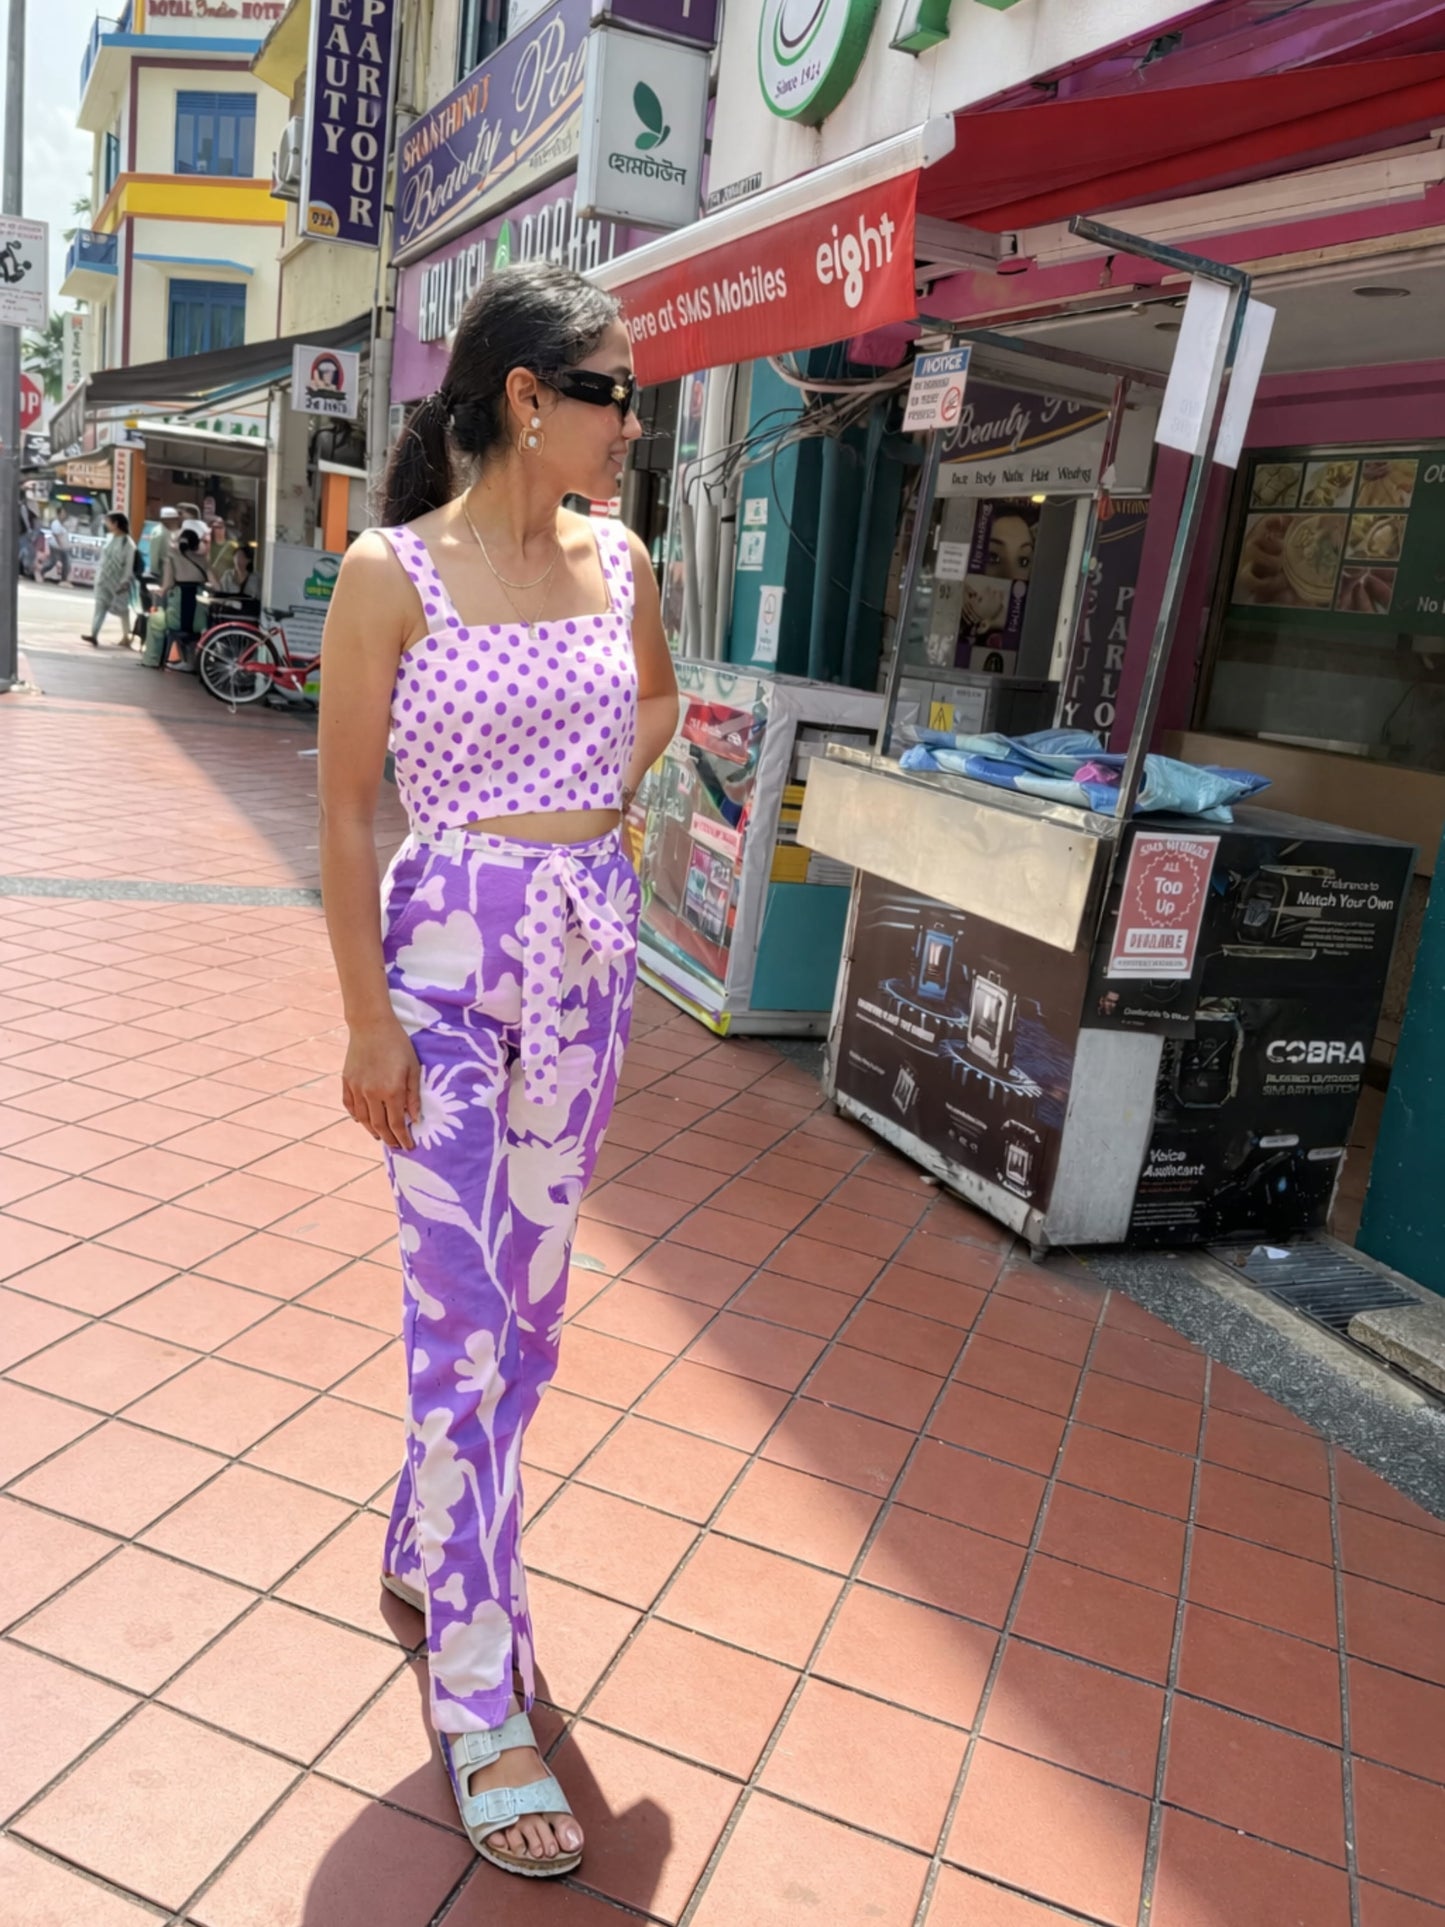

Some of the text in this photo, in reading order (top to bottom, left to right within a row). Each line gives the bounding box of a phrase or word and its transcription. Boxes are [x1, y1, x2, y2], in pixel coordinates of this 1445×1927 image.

[775, 76, 798, 98] Since
[349, 0, 387, 228] PARLOUR
[400, 118, 503, 245] Beauty
[816, 211, 895, 308] eight
[658, 302, 676, 333] at
[677, 285, 712, 327] SMS
[713, 265, 787, 317] Mobiles
[922, 352, 963, 375] NOTICE
[942, 403, 1031, 452] Beauty
[1417, 596, 1438, 613] No
[1163, 862, 1180, 873] ALL
[1156, 899, 1175, 917] Up
[1297, 891, 1394, 910] Match Your Own
[1266, 1040, 1366, 1064] COBRA
